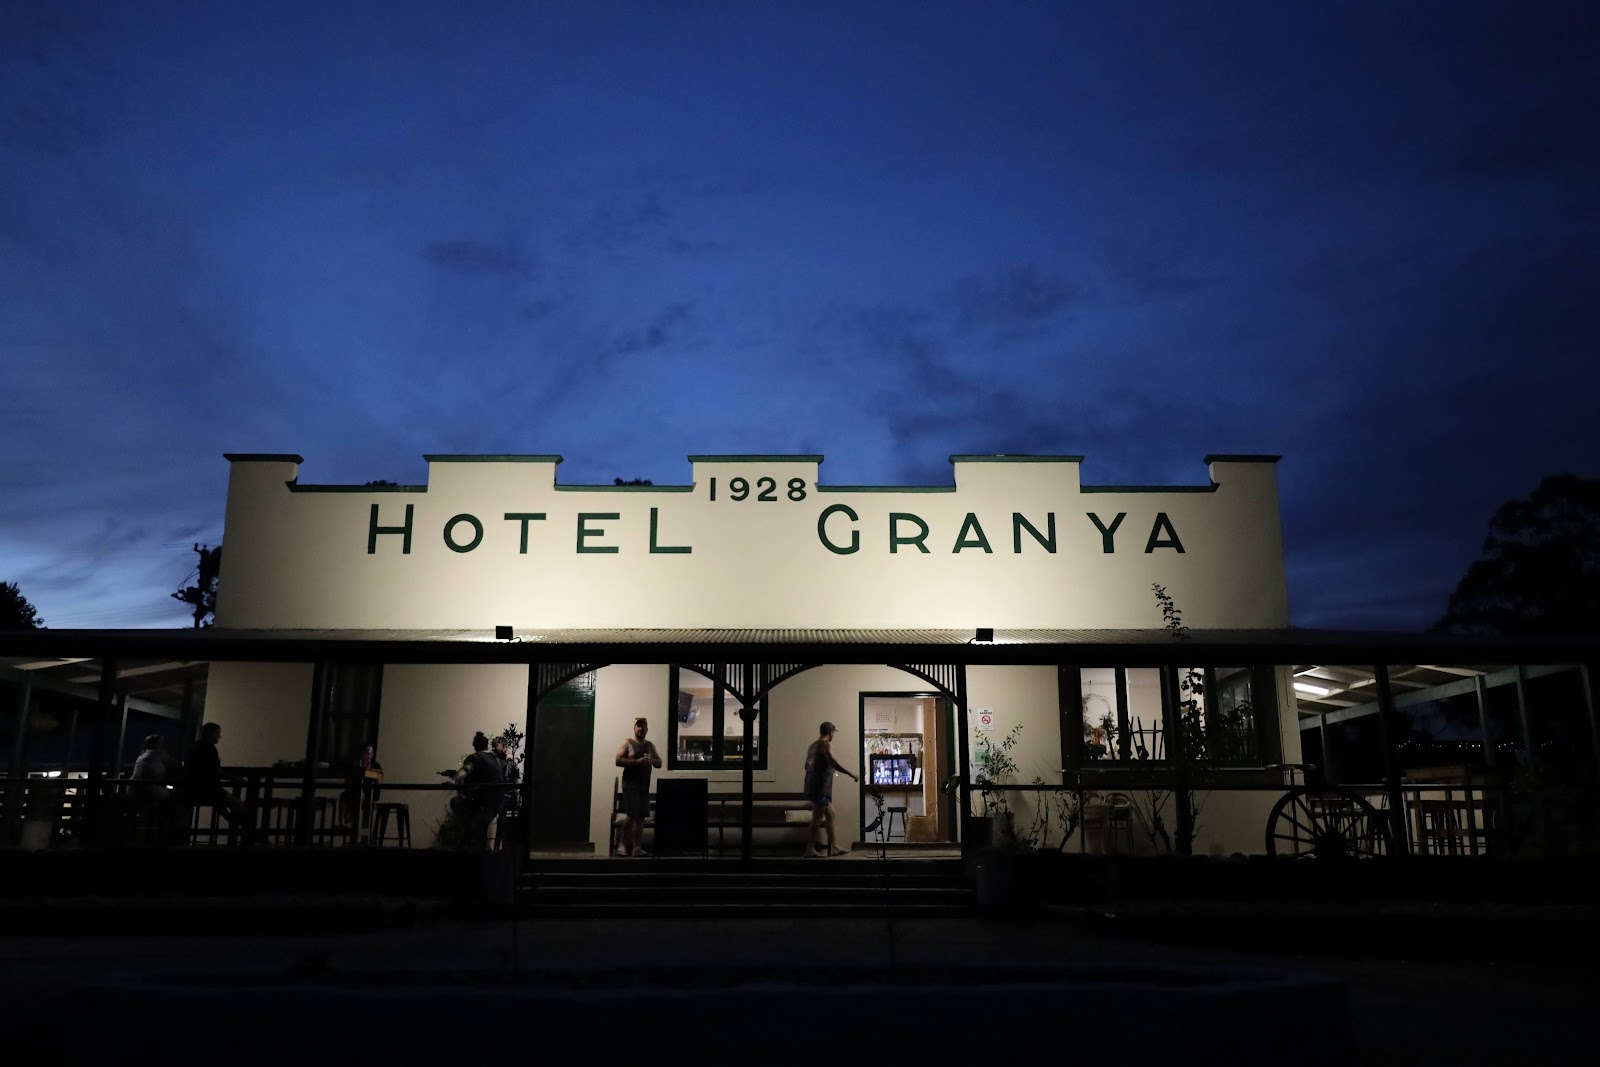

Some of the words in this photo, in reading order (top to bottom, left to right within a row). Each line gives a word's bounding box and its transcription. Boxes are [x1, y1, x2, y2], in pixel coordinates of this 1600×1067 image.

[710, 477, 806, 502] 1928
[367, 504, 692, 554] HOTEL
[818, 504, 1185, 555] GRANYA
